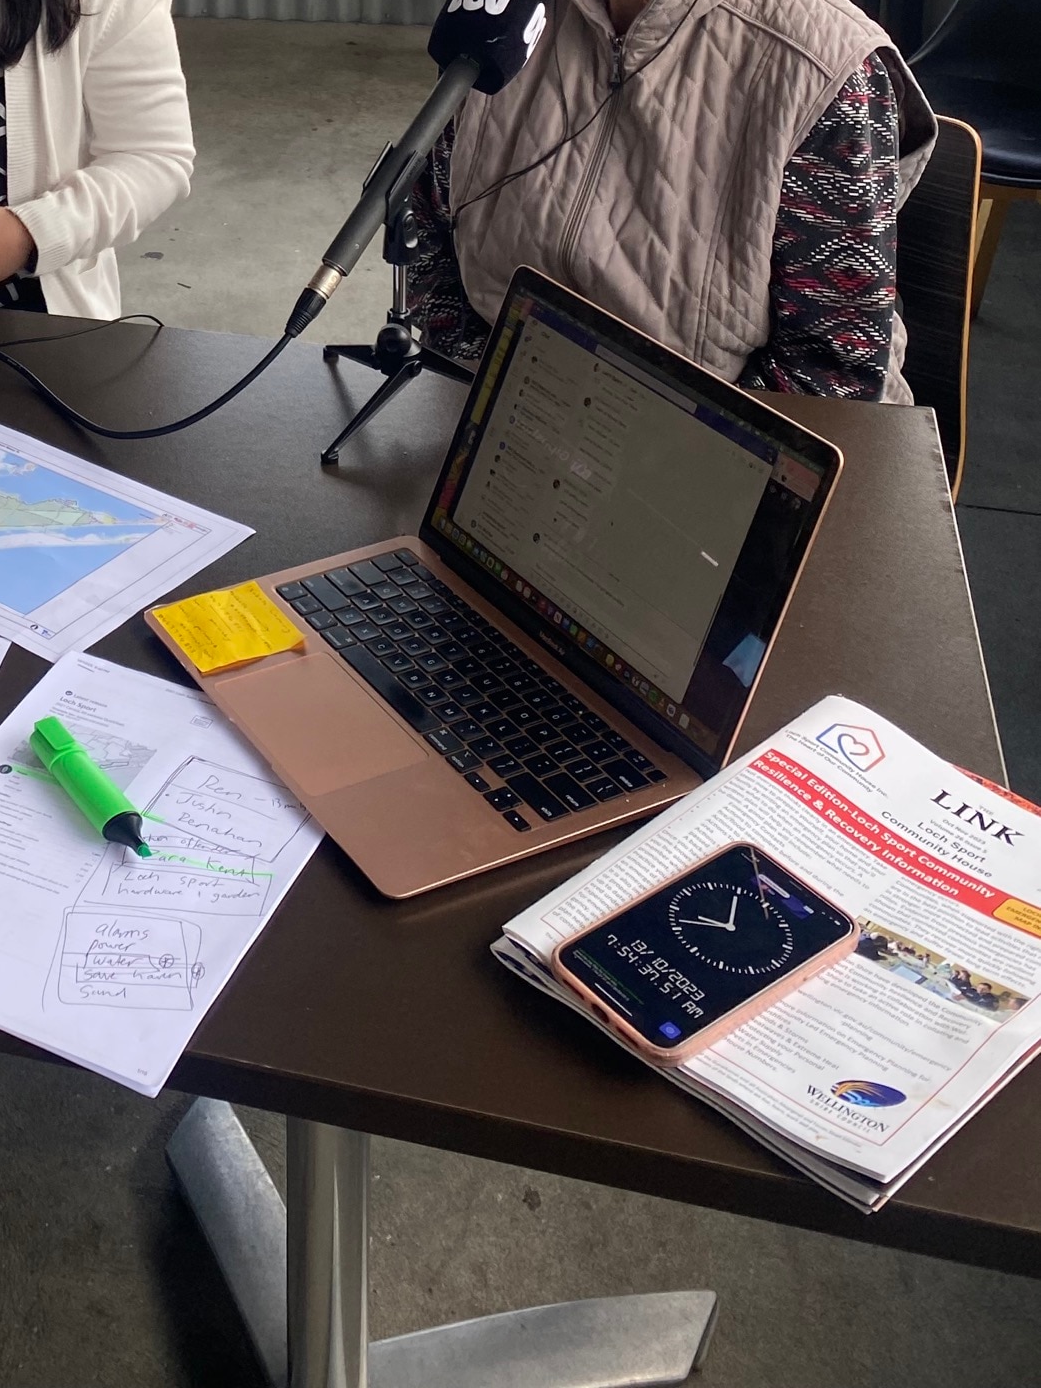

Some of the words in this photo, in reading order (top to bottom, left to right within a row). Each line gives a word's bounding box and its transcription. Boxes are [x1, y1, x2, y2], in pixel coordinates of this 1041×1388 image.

[59, 696, 77, 705] Loch
[75, 702, 97, 713] Sport
[751, 759, 814, 801] Resilience
[809, 799, 828, 810] &
[822, 808, 883, 852] Recovery
[880, 849, 961, 895] Information
[762, 751, 809, 780] Special
[805, 778, 883, 833] Edition-Loch
[877, 831, 920, 858] Sport
[914, 854, 997, 899] Community
[928, 789, 1026, 846] LINK
[877, 810, 951, 856] Community
[950, 853, 994, 878] House
[915, 821, 950, 843] Loch
[948, 841, 987, 864] Sport
[652, 958, 706, 1002] 10/2023
[681, 1002, 705, 1019] AM
[802, 1084, 890, 1133] WELLINGTON
